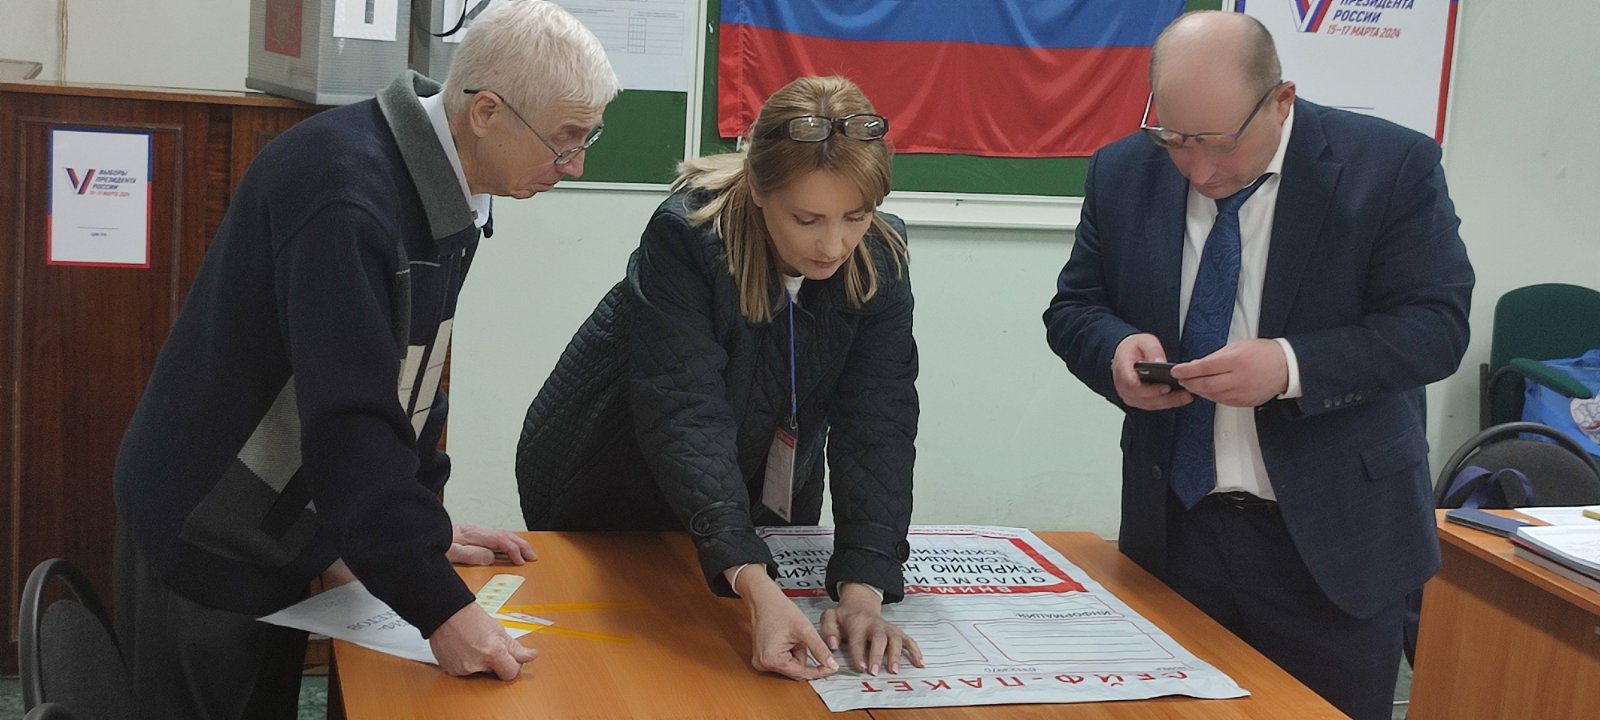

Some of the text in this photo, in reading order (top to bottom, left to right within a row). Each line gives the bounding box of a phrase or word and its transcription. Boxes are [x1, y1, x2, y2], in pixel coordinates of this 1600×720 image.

[1333, 9, 1382, 23] РОССИИ
[1350, 25, 1380, 37] МАРТА
[1379, 27, 1401, 39] 2024
[860, 670, 1189, 694] СЕЙФ-ПАКЕТ
